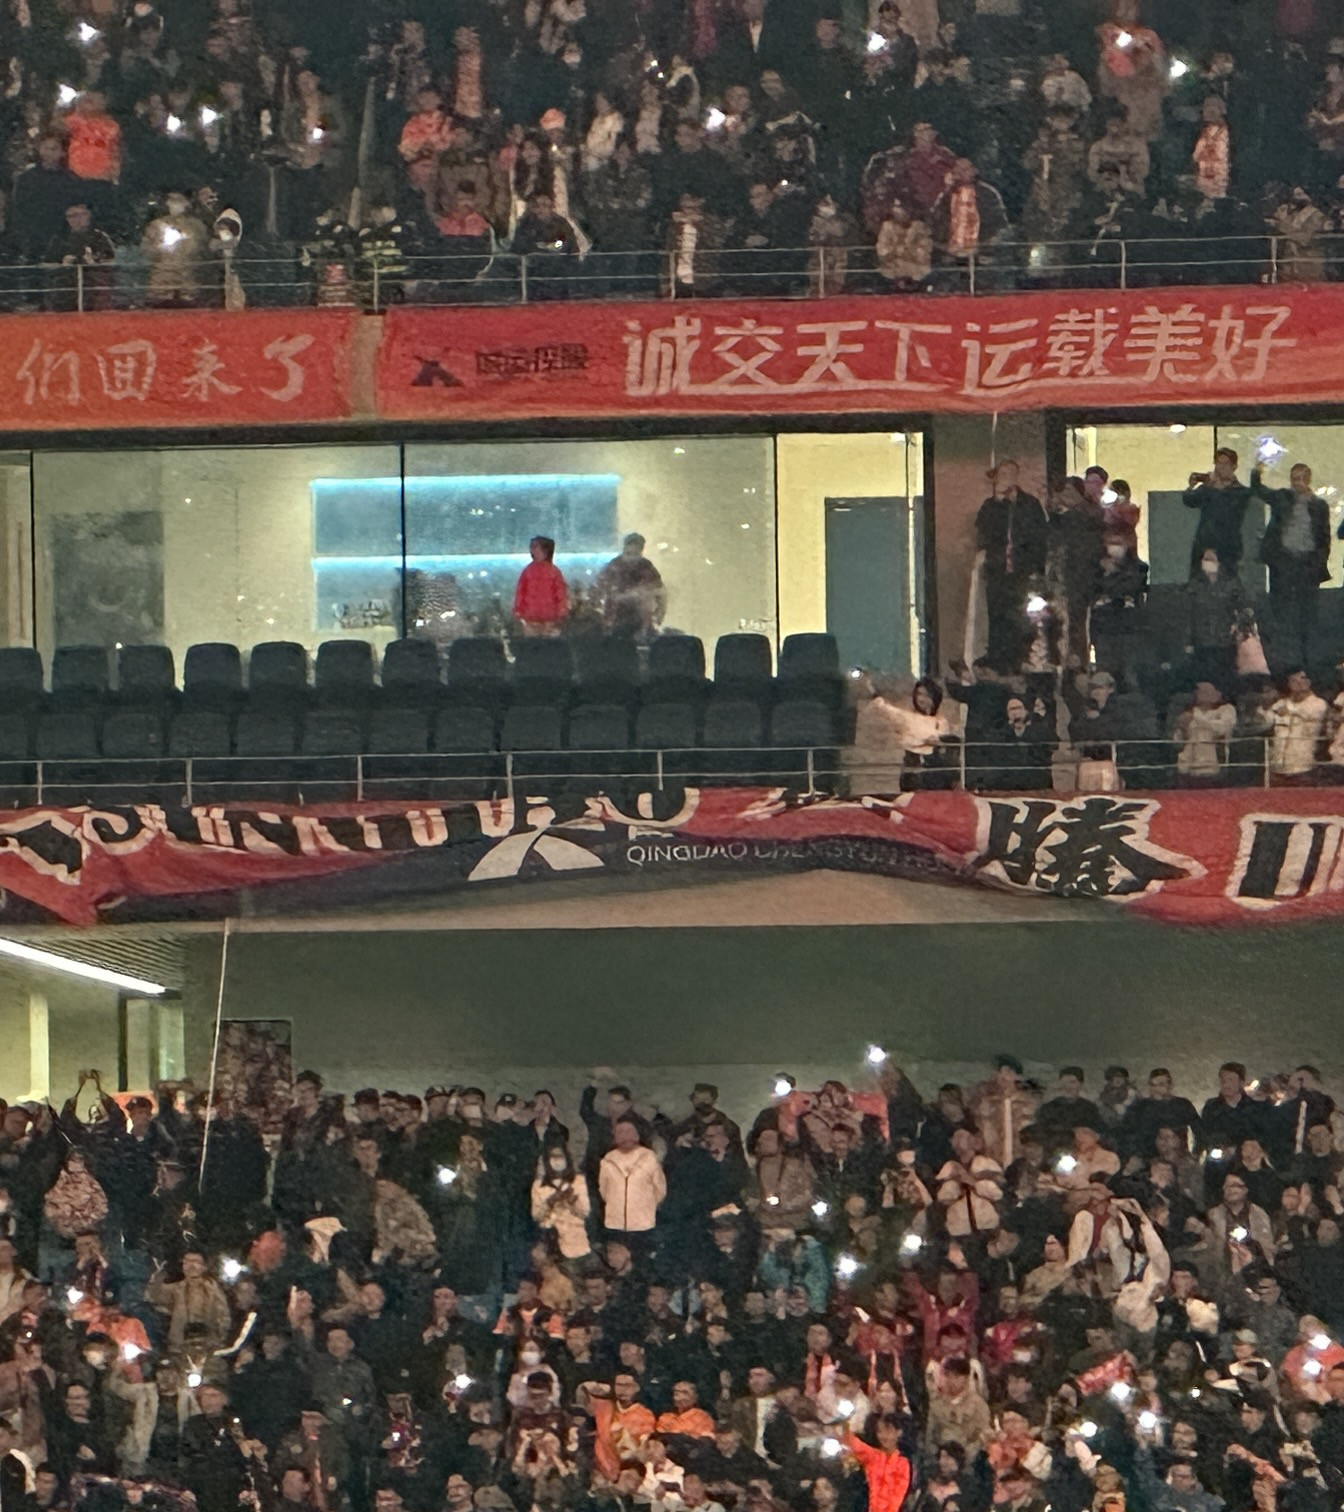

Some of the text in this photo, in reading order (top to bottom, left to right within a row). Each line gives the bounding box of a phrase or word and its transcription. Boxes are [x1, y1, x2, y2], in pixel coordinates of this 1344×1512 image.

[620, 304, 1298, 398] 诚交天下运载美好
